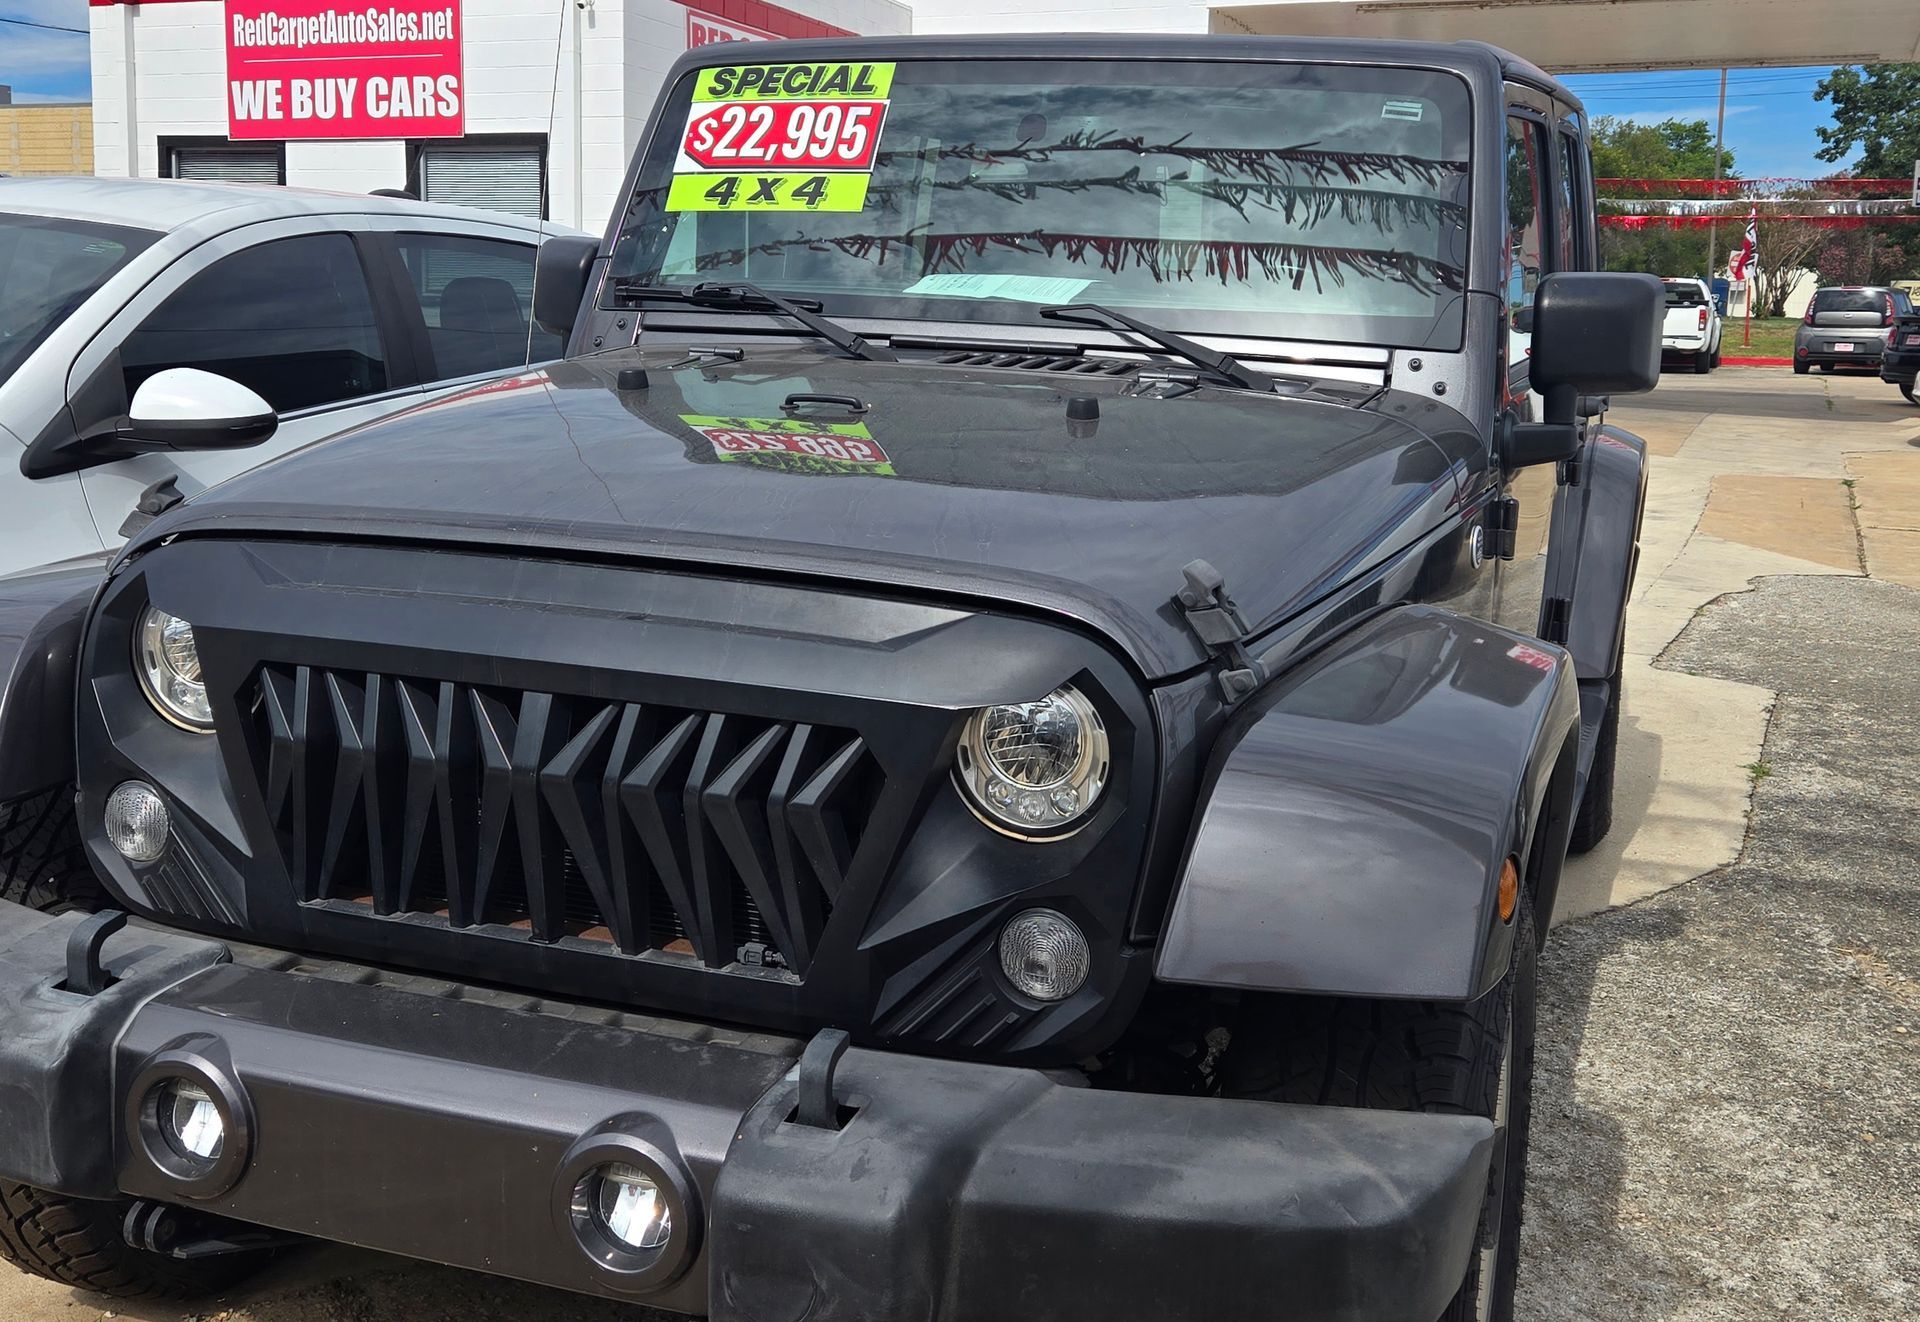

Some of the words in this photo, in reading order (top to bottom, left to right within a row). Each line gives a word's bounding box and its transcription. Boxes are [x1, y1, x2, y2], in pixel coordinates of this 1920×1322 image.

[233, 7, 454, 49] RedCarpetAutoSales.net
[231, 79, 284, 121] WE
[291, 77, 358, 120] BUY
[366, 74, 460, 119] CARS
[707, 64, 878, 98] SPECIAL
[692, 104, 873, 162] $22,995
